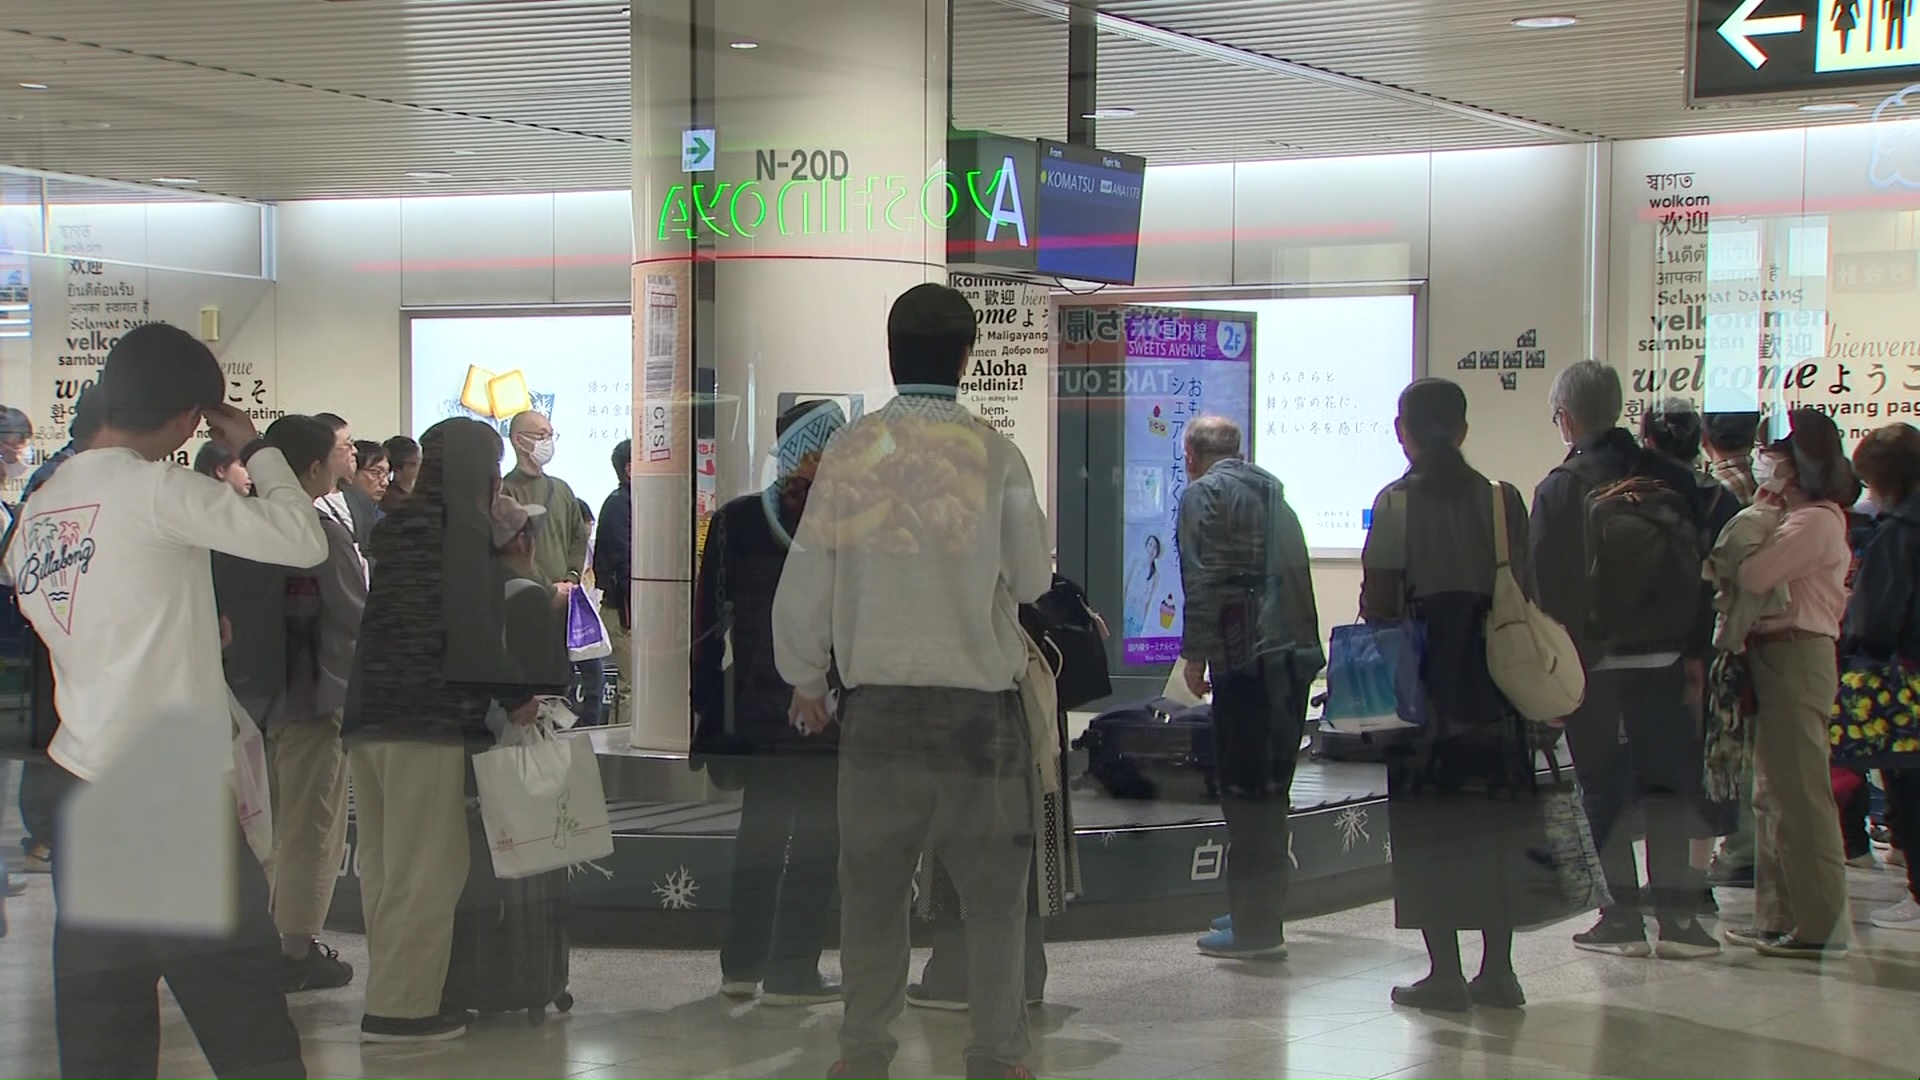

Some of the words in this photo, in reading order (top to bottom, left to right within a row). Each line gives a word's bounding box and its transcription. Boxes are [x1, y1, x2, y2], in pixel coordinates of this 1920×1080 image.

[756, 149, 849, 181] N-20D
[1047, 170, 1095, 193] KOMATSU
[1112, 183, 1140, 199] ANA1173
[985, 156, 1029, 247] A
[1649, 195, 1710, 208] wolkom
[1659, 211, 1709, 237] 欢迎
[1658, 288, 1731, 305] Selamat
[1223, 325, 1242, 351] 2F
[1128, 341, 1167, 357] SWEETS
[1169, 342, 1206, 359] AVENUE
[972, 359, 1027, 377] Aloha
[1632, 355, 1818, 393] welcome
[961, 378, 1024, 395] geldiniz!
[980, 403, 1009, 416] bem-
[652, 406, 665, 448] CTS
[19, 537, 96, 595] Billabong
